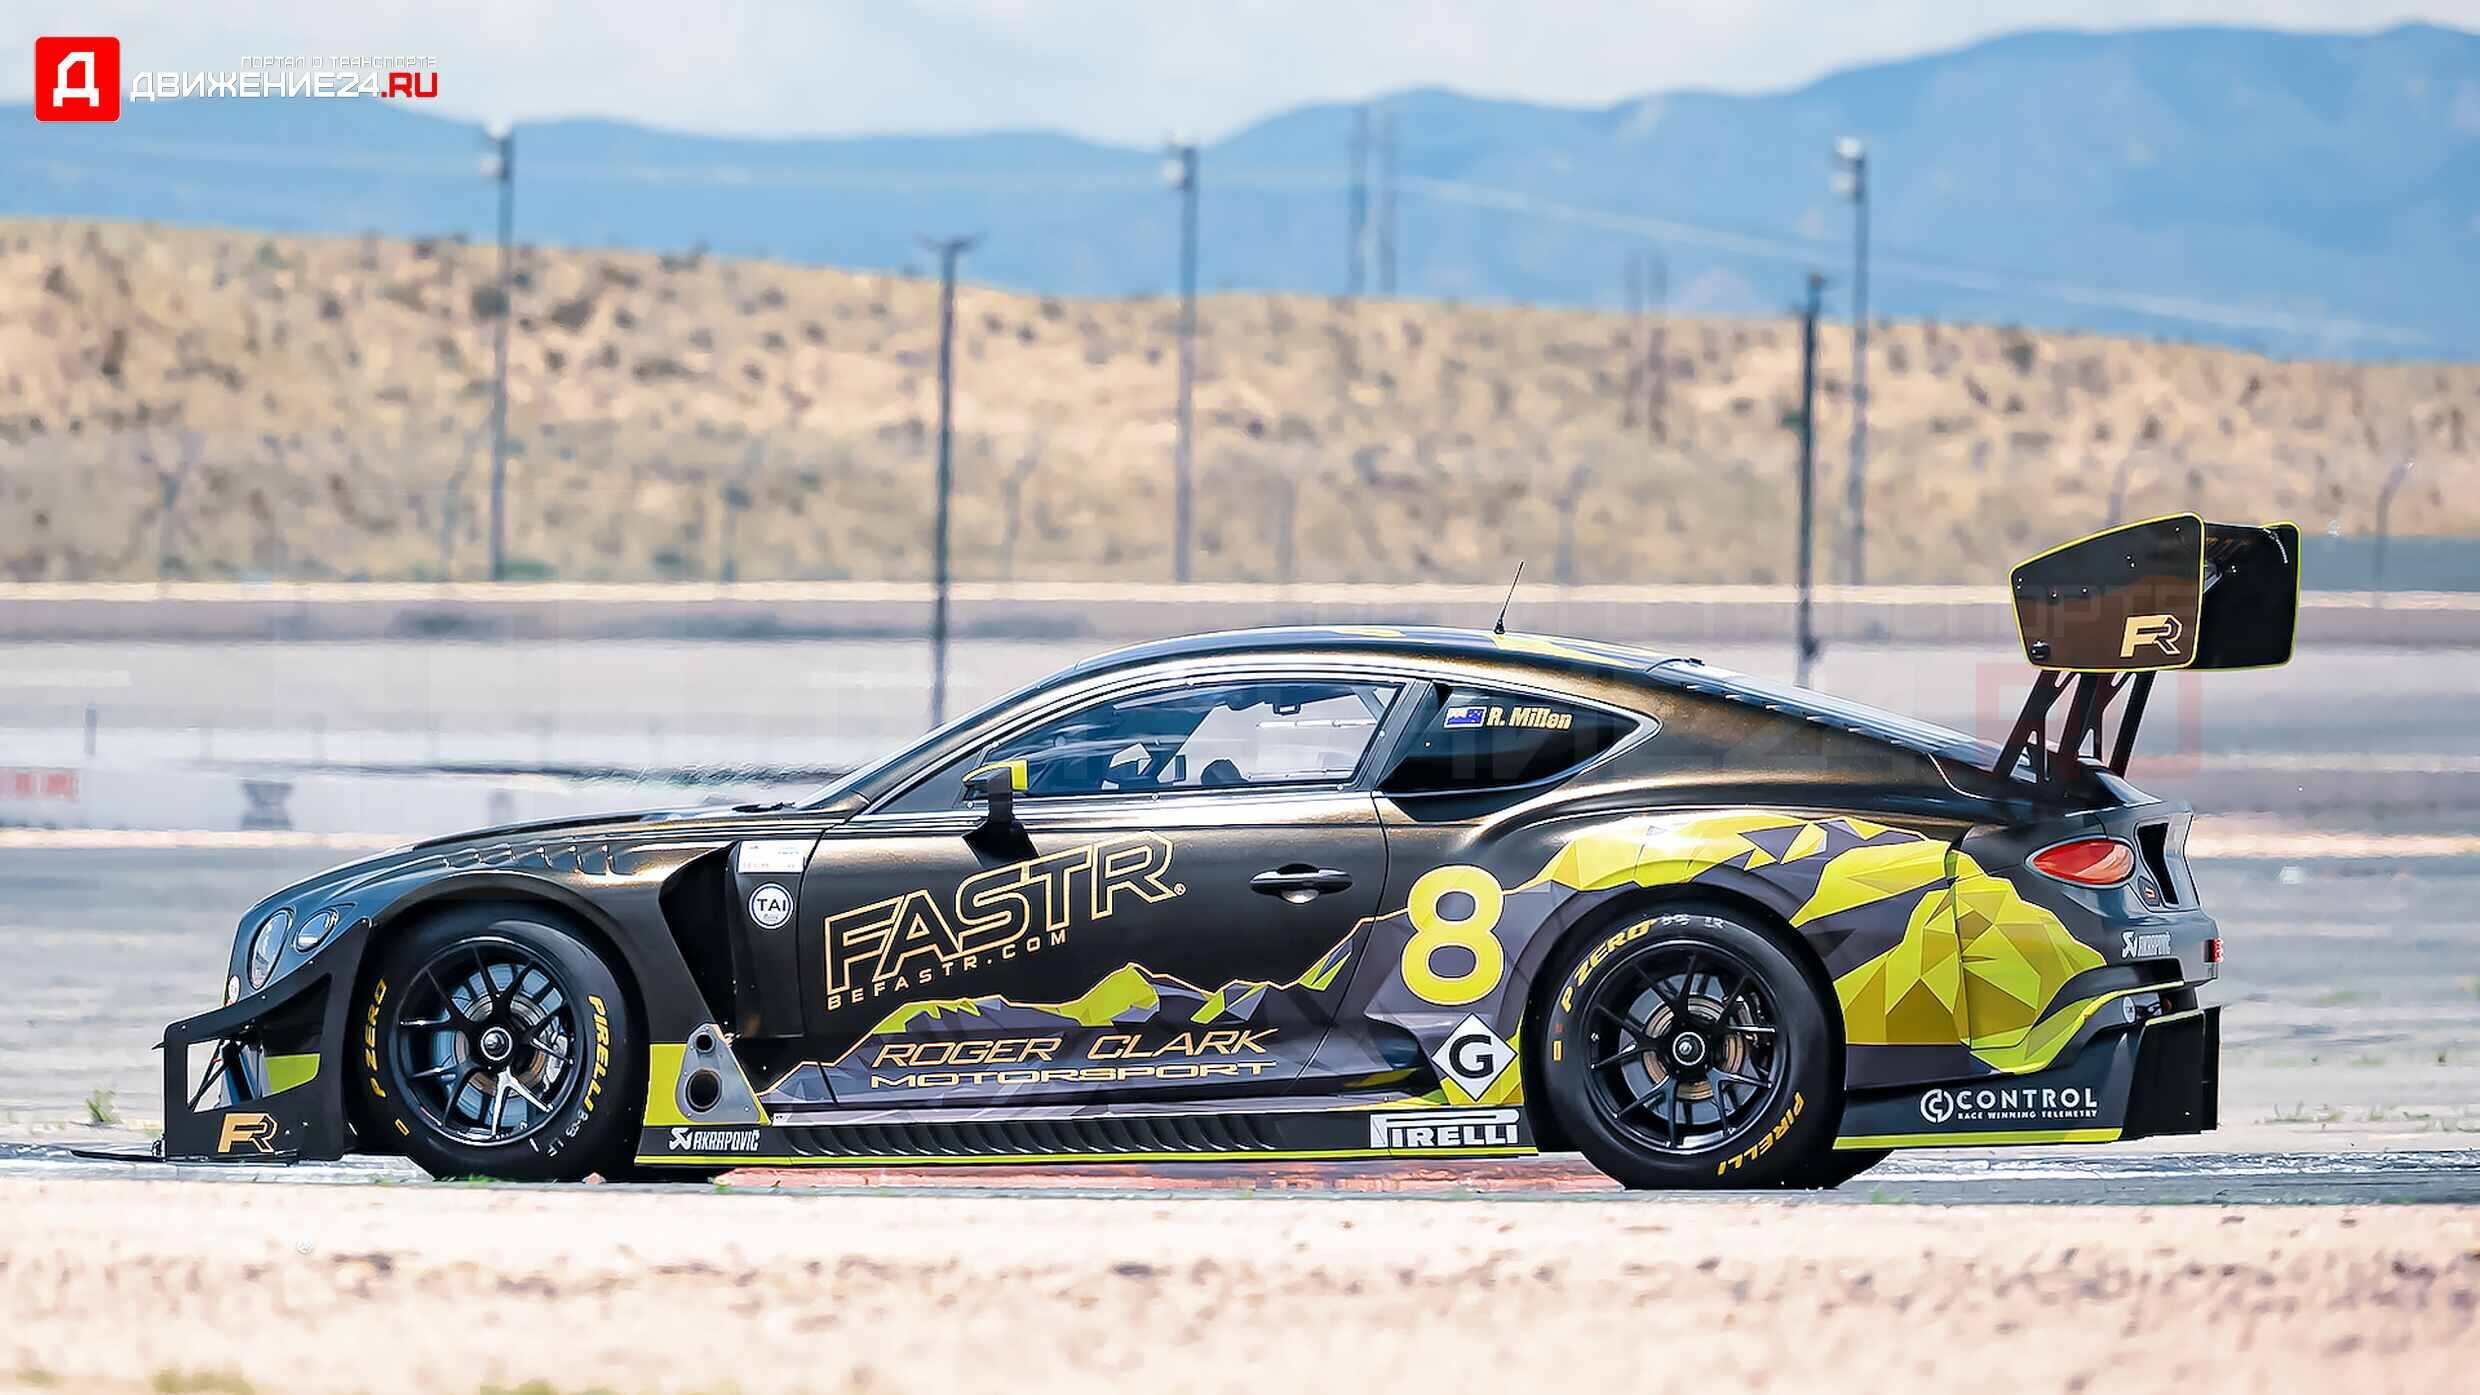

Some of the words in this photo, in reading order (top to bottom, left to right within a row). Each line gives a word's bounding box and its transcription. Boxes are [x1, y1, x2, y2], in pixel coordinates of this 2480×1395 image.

[1486, 706, 1506, 727] R.
[757, 898, 787, 912] TAI
[1400, 864, 1505, 1006] 8
[827, 929, 1068, 1010] BEFASTR.COM
[1559, 985, 1576, 1015] P
[1573, 917, 1658, 988] ZERO
[364, 978, 388, 1072] ZERO
[587, 994, 611, 1113] PIRELLI
[872, 1036, 1062, 1068] ROGER
[1088, 1028, 1281, 1060] CLARK
[1449, 1033, 1494, 1079] G
[871, 1061, 1278, 1089] MOTORSPORT
[1956, 1087, 2098, 1110] CONTROL
[1957, 1111, 1983, 1120] RACE
[1987, 1111, 2037, 1120] WINNING
[2041, 1109, 2098, 1119] TELEMETRY
[1370, 1111, 1520, 1149] PIRELLI
[1716, 1091, 1804, 1178] PIRELLI
